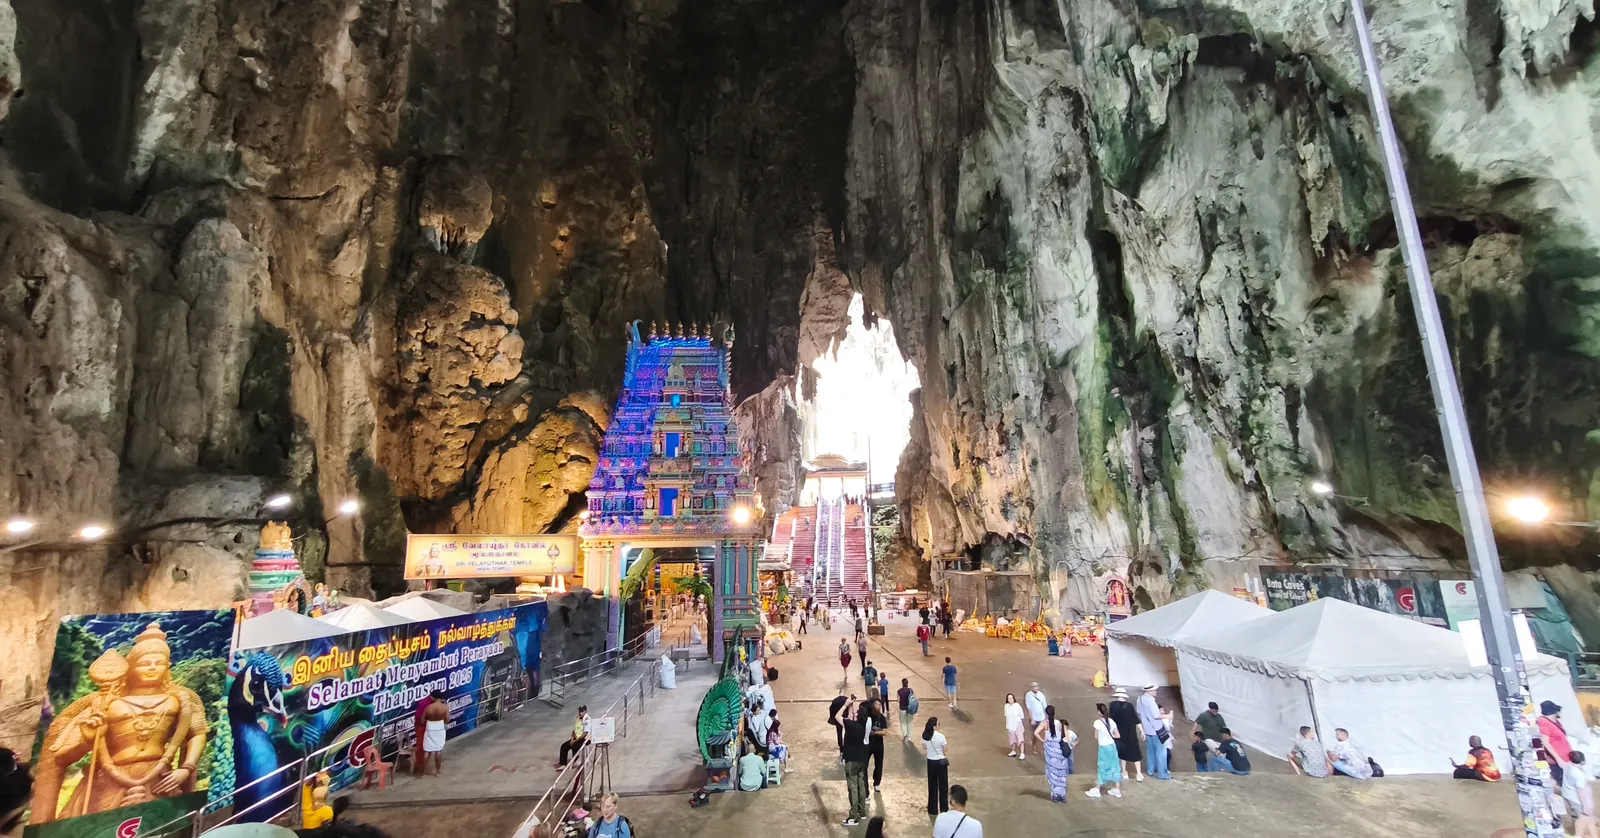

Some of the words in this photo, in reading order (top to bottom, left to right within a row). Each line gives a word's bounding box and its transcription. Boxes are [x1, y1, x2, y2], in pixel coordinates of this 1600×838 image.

[1266, 578, 1282, 588] Batu
[292, 647, 354, 685] இனிய
[358, 629, 431, 667] தைப்பூசம்
[438, 614, 517, 648] நல்வாழ்த்துக்கள்
[307, 672, 382, 709] Selamat
[385, 650, 459, 687] Menyambut
[461, 640, 505, 664] Perayaan
[373, 678, 447, 715] Thaipusam
[448, 667, 473, 690] 2025
